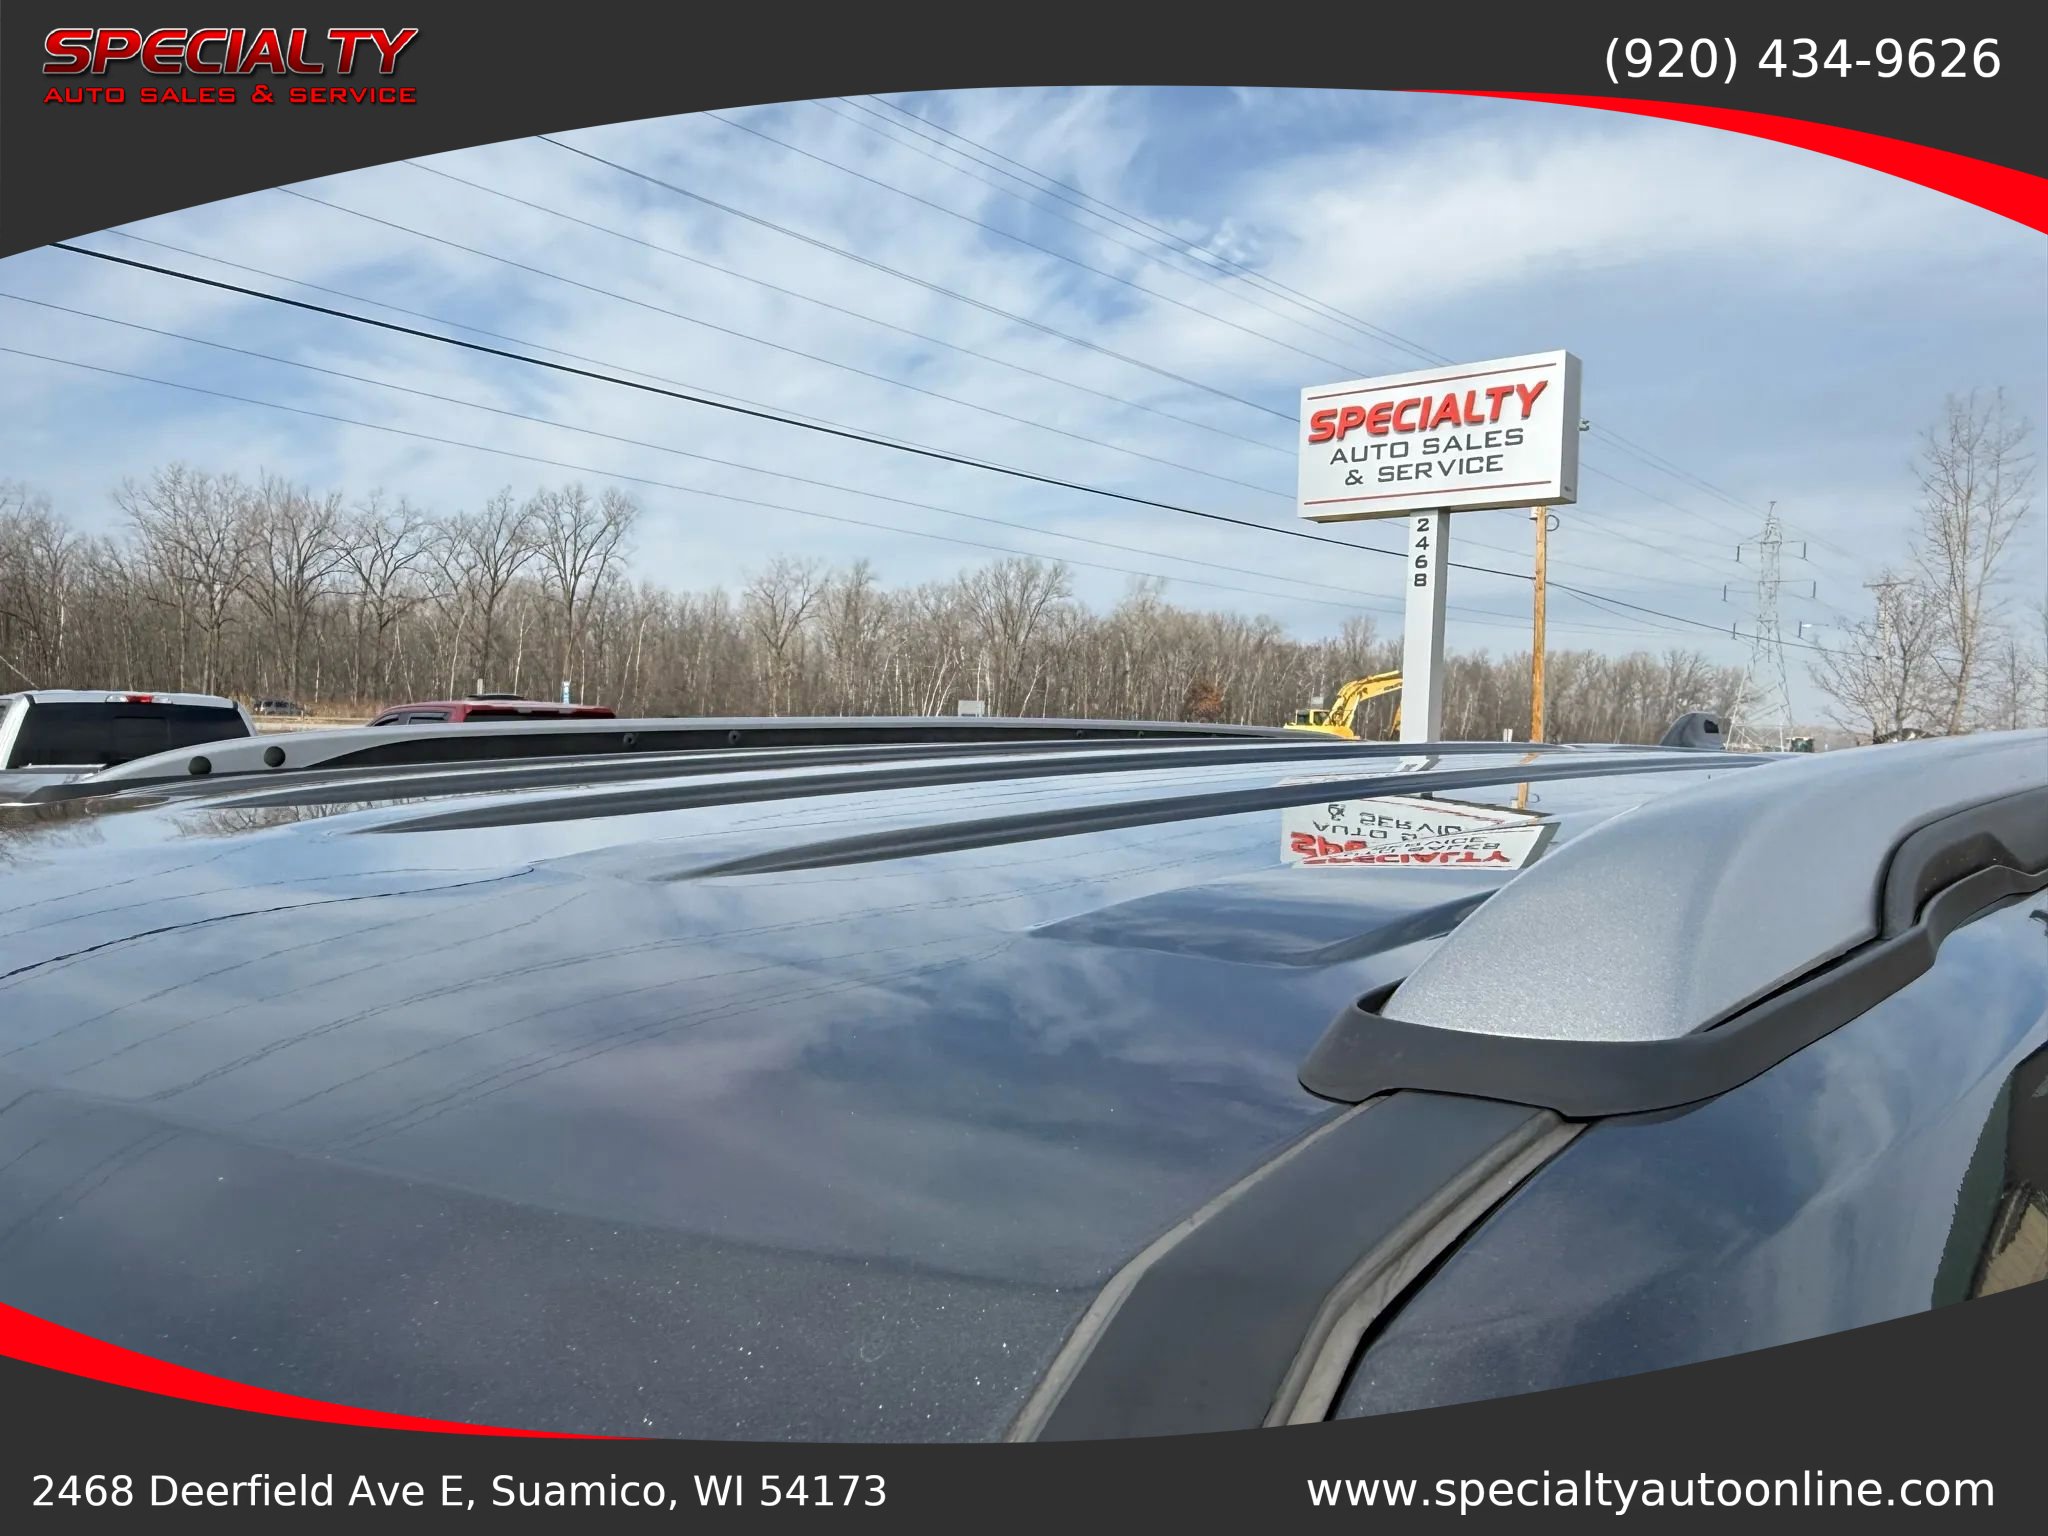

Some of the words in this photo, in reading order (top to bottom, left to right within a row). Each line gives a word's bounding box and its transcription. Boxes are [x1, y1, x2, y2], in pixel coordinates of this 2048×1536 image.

[1307, 379, 1549, 445] SPECIALTY
[1329, 440, 1410, 466] AUTO
[1422, 427, 1525, 455] SALES
[1344, 469, 1364, 486] &
[1377, 453, 1505, 483] SERVICE
[1413, 517, 1430, 588] 2468
